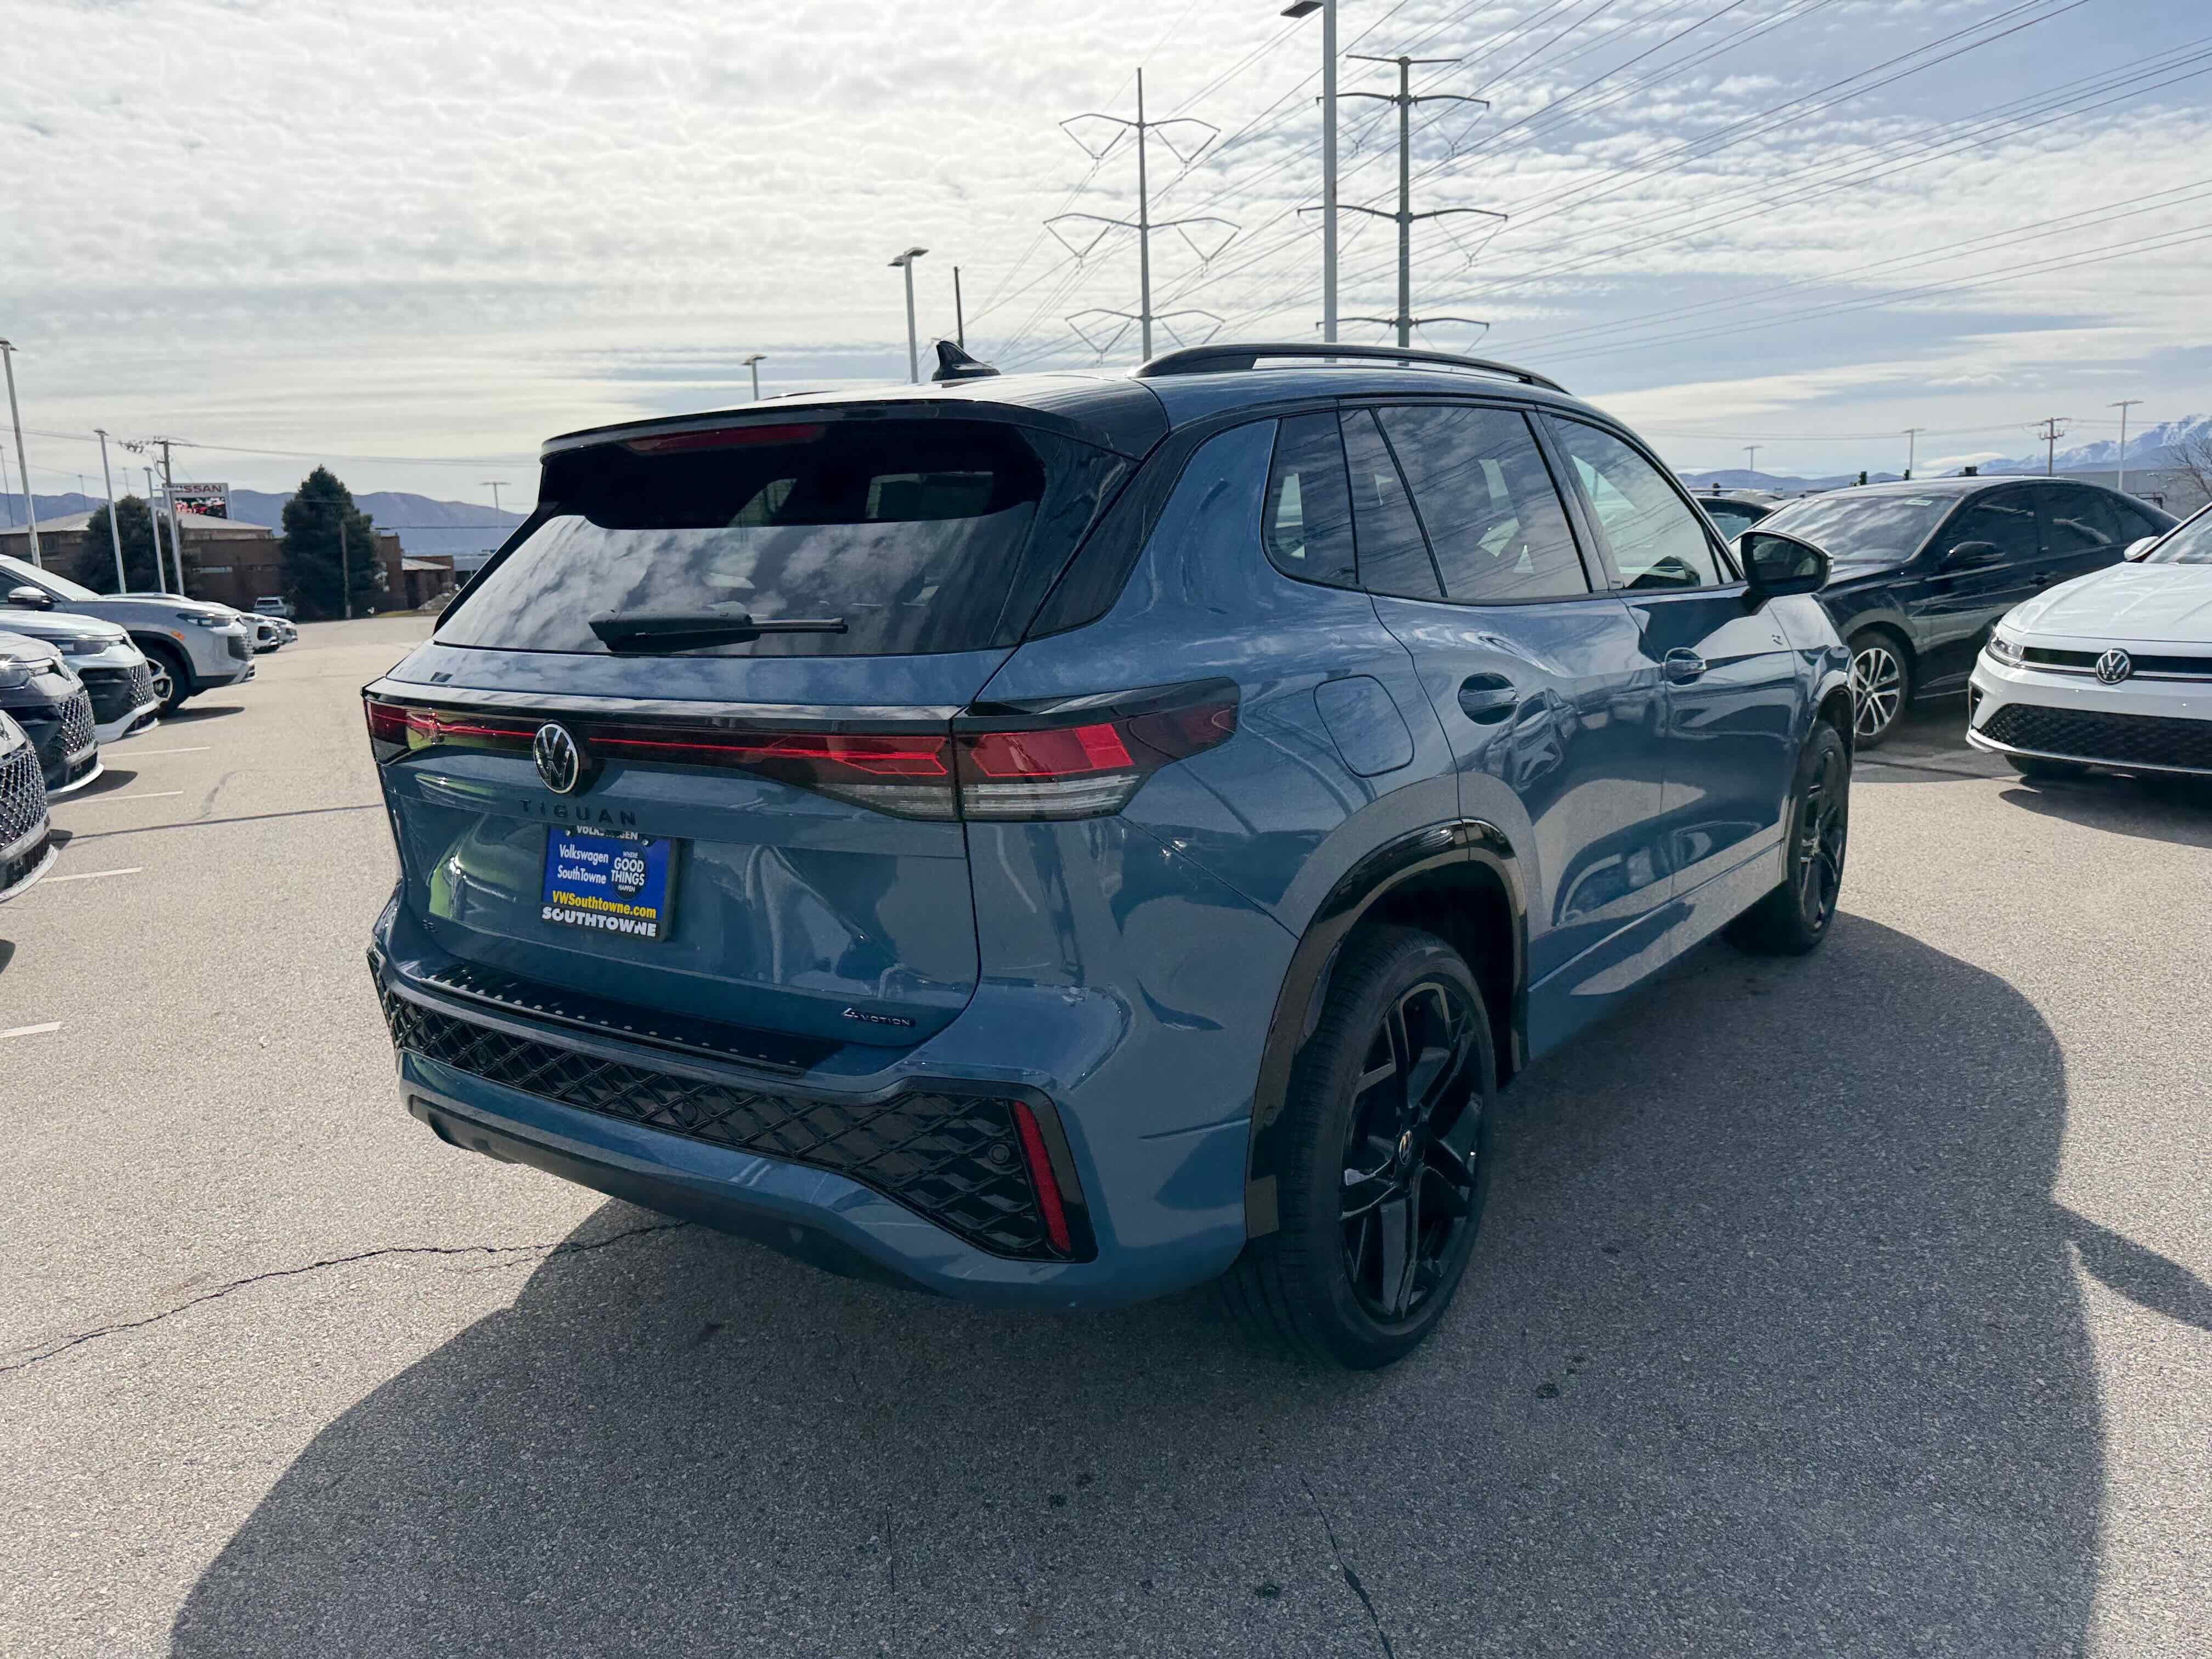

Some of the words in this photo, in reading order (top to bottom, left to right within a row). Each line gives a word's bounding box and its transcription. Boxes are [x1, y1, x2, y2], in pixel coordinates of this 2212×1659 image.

[518, 799, 636, 826] TIGUAN
[559, 844, 609, 865] Volkswagen
[557, 865, 606, 884] SouthTowne
[614, 857, 645, 873] GOOD
[611, 869, 645, 886] THINGS
[618, 884, 636, 893] HAPPEN
[552, 890, 657, 919] VWSouthtowne.com
[541, 906, 657, 938] SOUTHTOWNE
